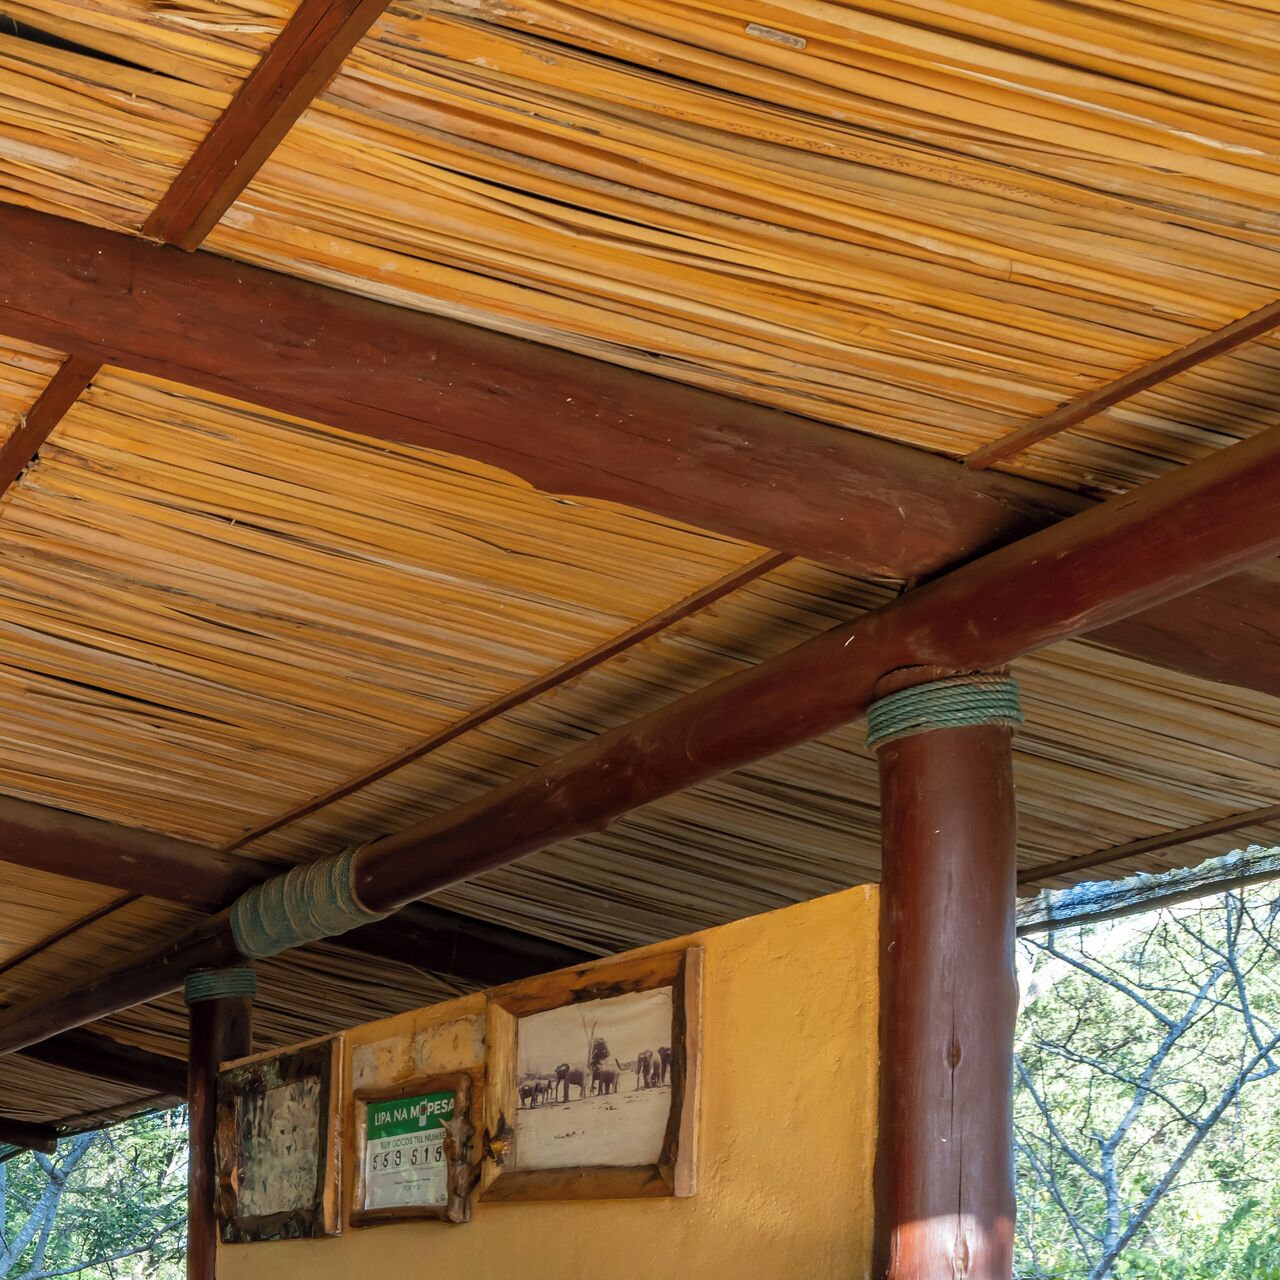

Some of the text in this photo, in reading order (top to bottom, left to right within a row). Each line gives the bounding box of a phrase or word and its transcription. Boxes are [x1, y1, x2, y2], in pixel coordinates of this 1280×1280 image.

[374, 1111, 392, 1126] LIPA
[393, 1107, 408, 1122] NA
[380, 1131, 446, 1151] BUY GOODS TILL NUMBE
